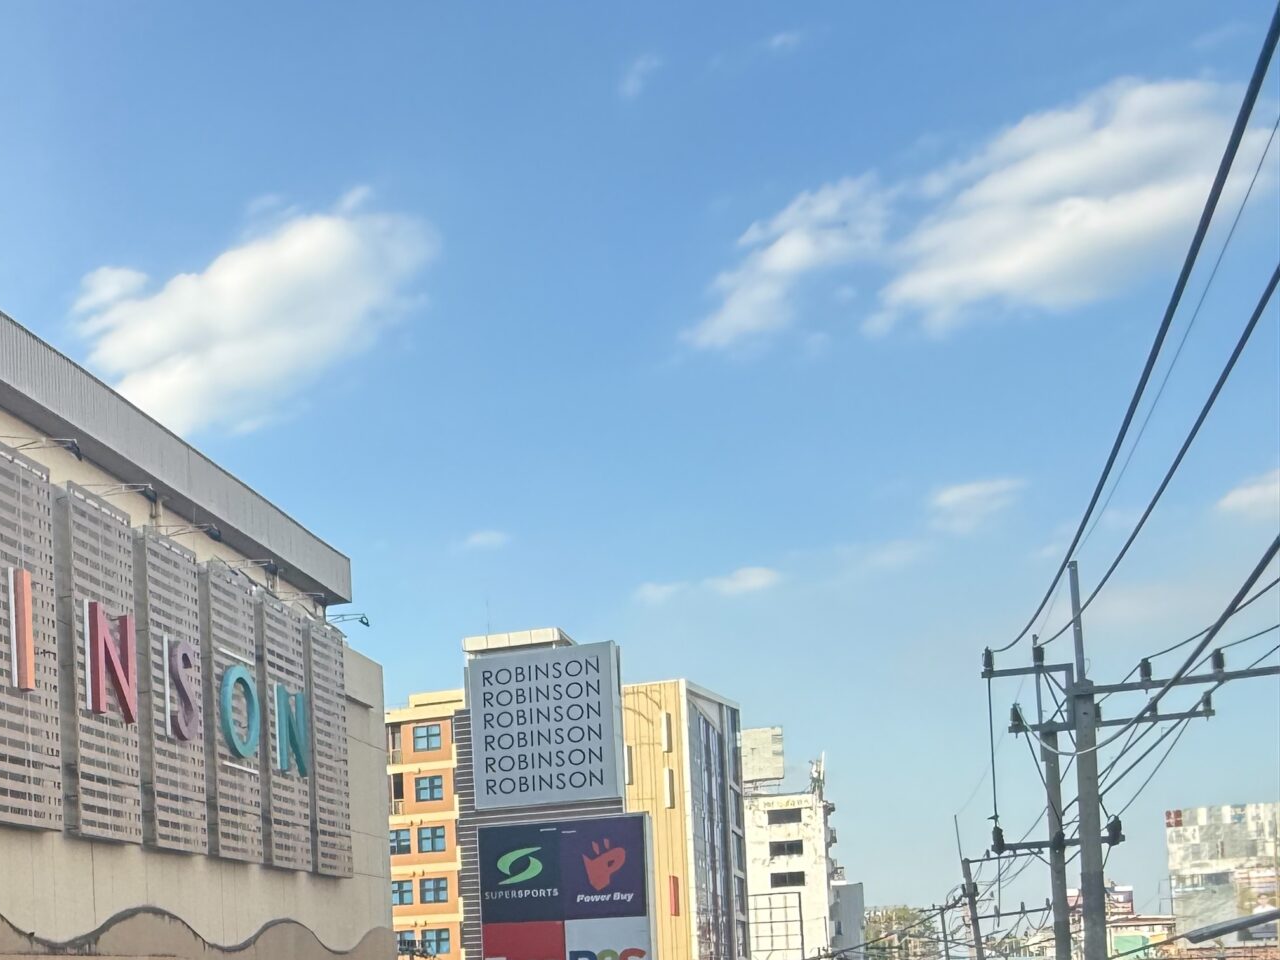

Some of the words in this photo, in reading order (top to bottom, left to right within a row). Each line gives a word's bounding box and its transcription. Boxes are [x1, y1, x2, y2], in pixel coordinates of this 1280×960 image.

[482, 655, 600, 687] ROBINSON
[483, 679, 600, 708] ROBINSON
[483, 701, 601, 730] ROBINSON
[484, 723, 602, 752] ROBINSON
[485, 746, 603, 773] ROBINSON
[486, 768, 604, 795] ROBINSON
[485, 888, 559, 900] SUPERSPORTS
